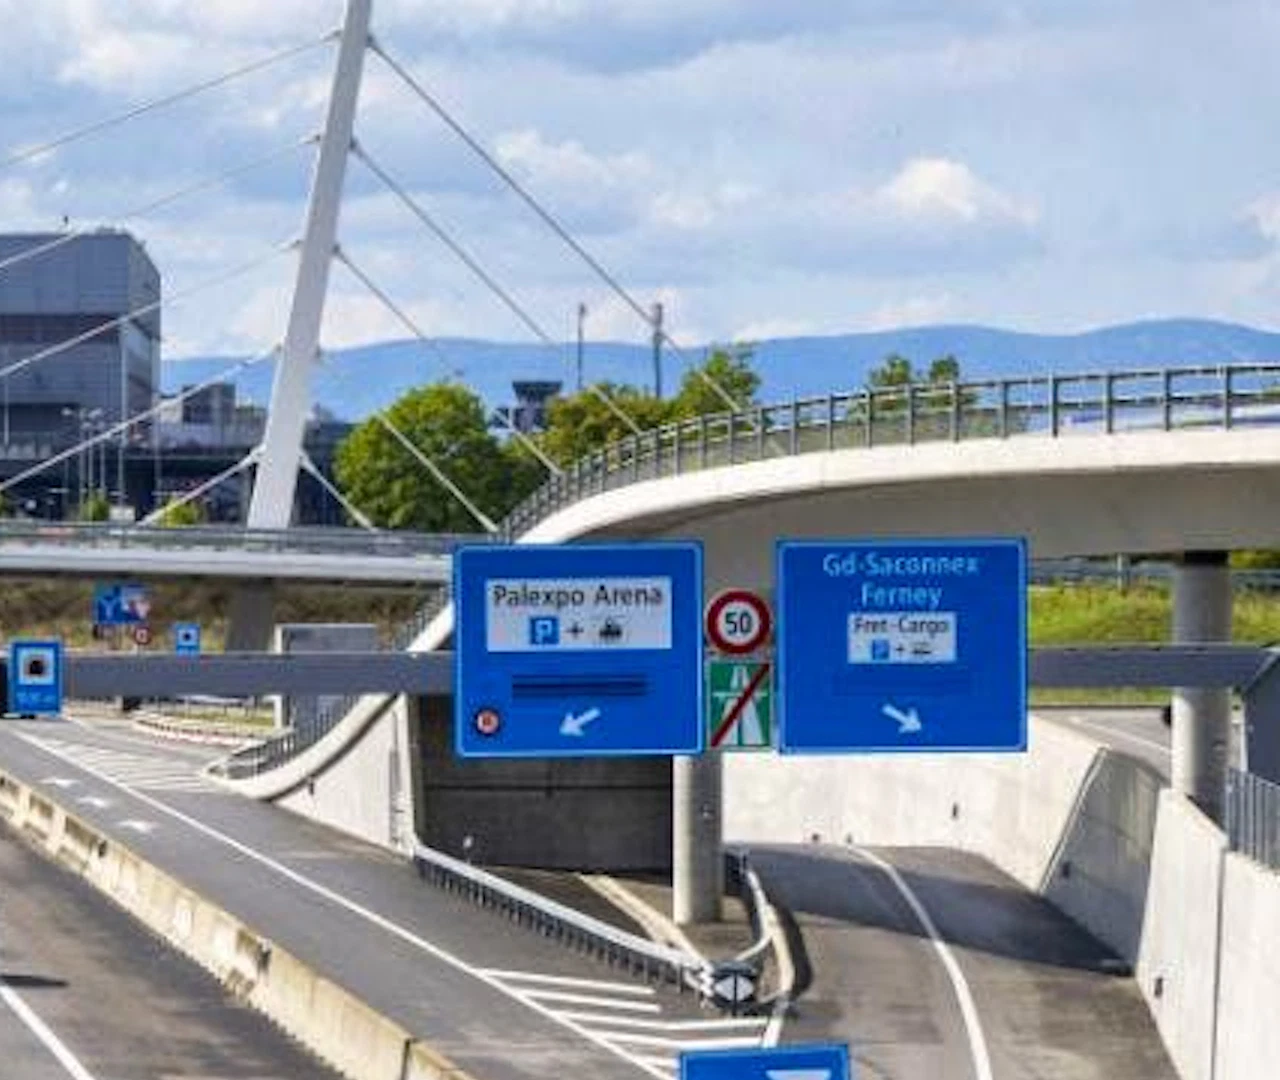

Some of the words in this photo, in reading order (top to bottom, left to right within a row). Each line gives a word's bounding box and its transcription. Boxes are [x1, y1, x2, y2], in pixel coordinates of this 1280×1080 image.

[822, 552, 979, 577] Gd-Saconnex
[492, 584, 585, 609] Palexpo
[595, 584, 663, 606] Arena
[860, 582, 942, 609] Ferney
[725, 610, 753, 635] 50
